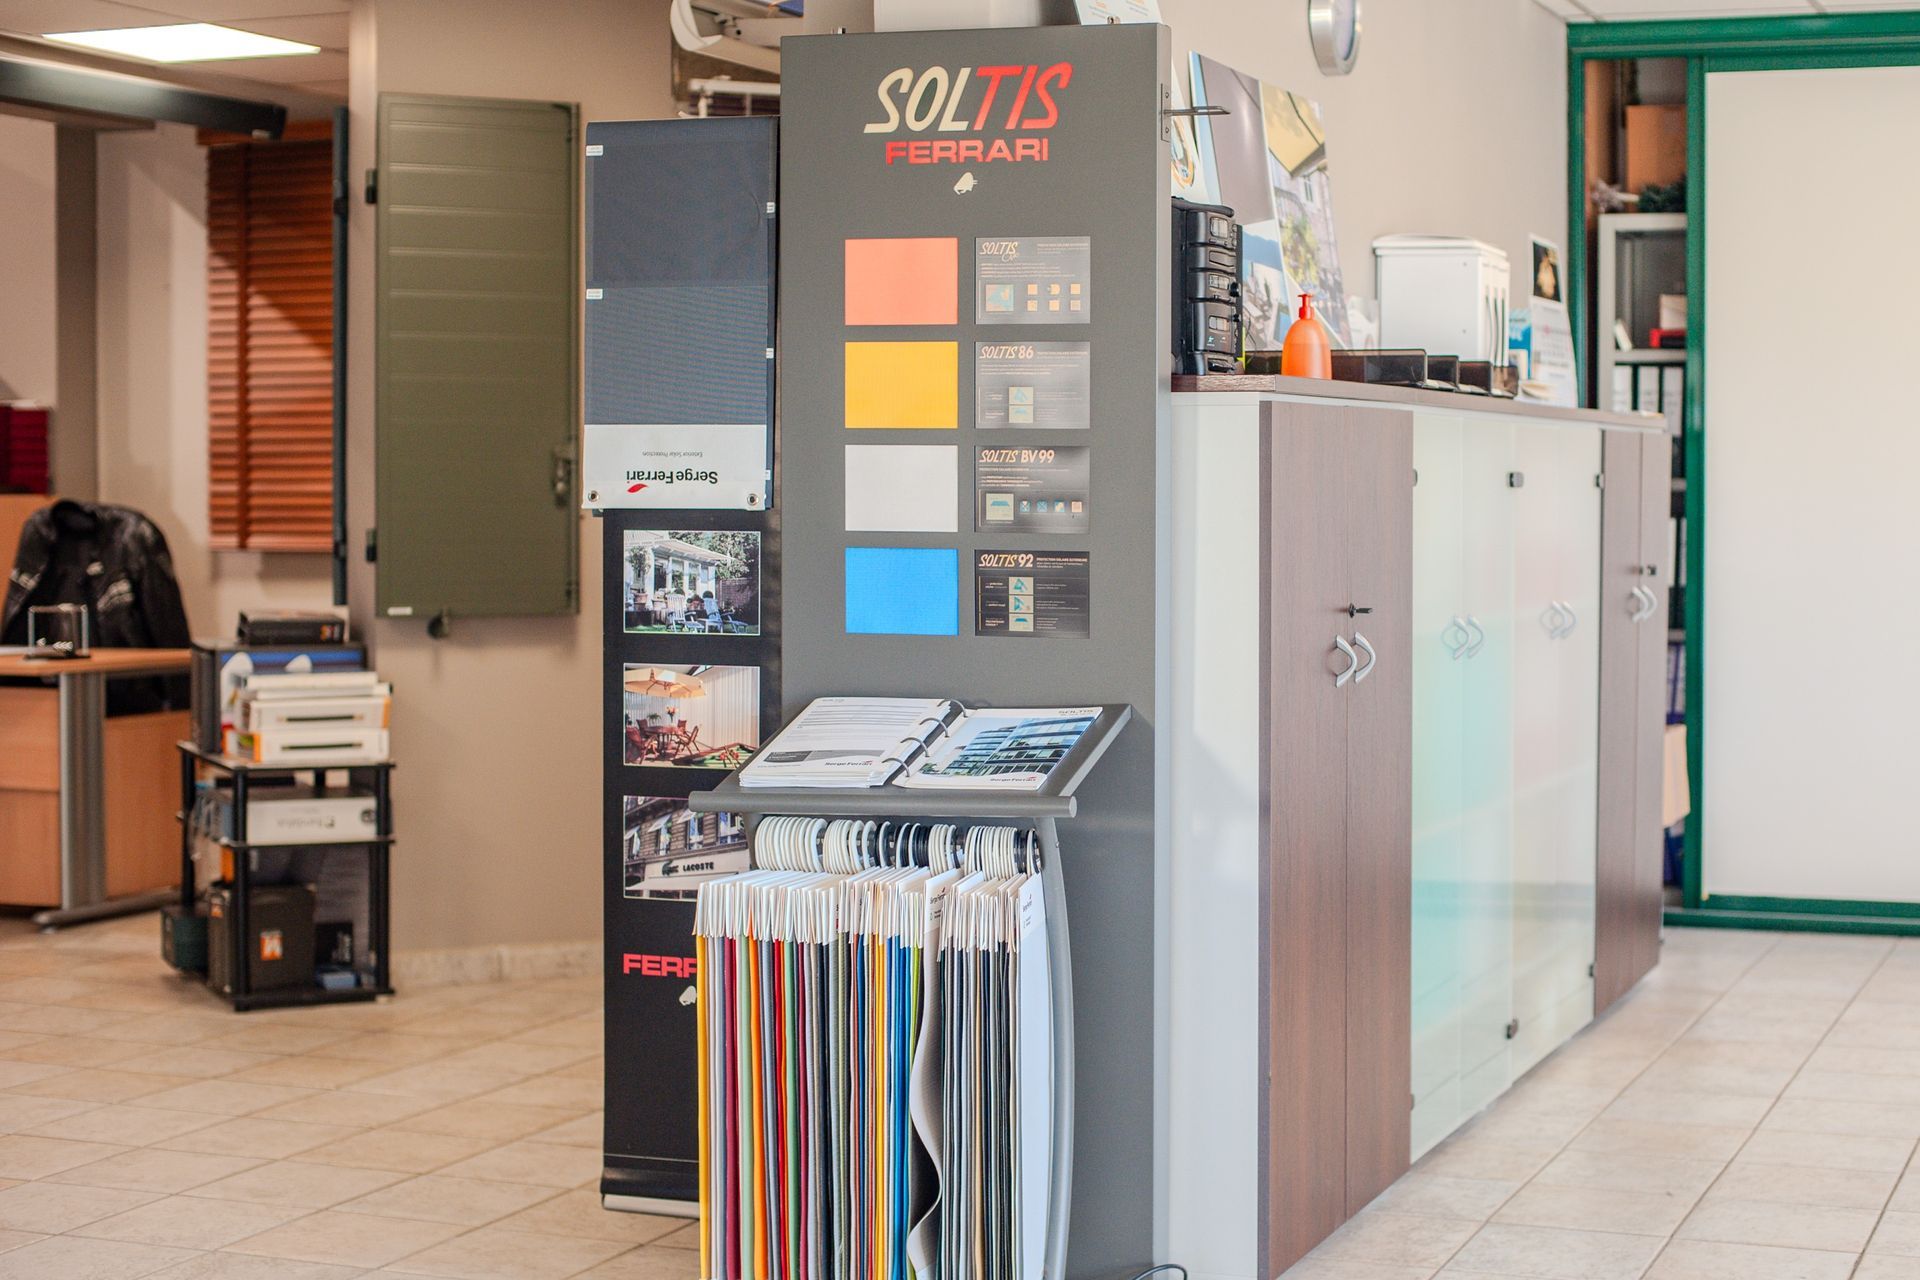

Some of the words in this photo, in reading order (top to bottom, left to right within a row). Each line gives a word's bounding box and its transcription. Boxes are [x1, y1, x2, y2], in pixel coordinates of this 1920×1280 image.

[863, 61, 1073, 134] SOLTIS
[885, 137, 1049, 165] FERRARI
[979, 241, 1018, 255] SOLTIS
[980, 345, 1017, 359] SOLTIS
[1018, 345, 1034, 359] 86
[979, 449, 1018, 463] SOLTIS
[1020, 449, 1038, 463] BV
[1038, 449, 1055, 463] 99
[626, 470, 674, 484] Ferrari
[676, 468, 718, 484] Serge
[978, 553, 1017, 567] SOLTIS
[1018, 553, 1034, 567] 92
[682, 861, 714, 872] LACOSTE
